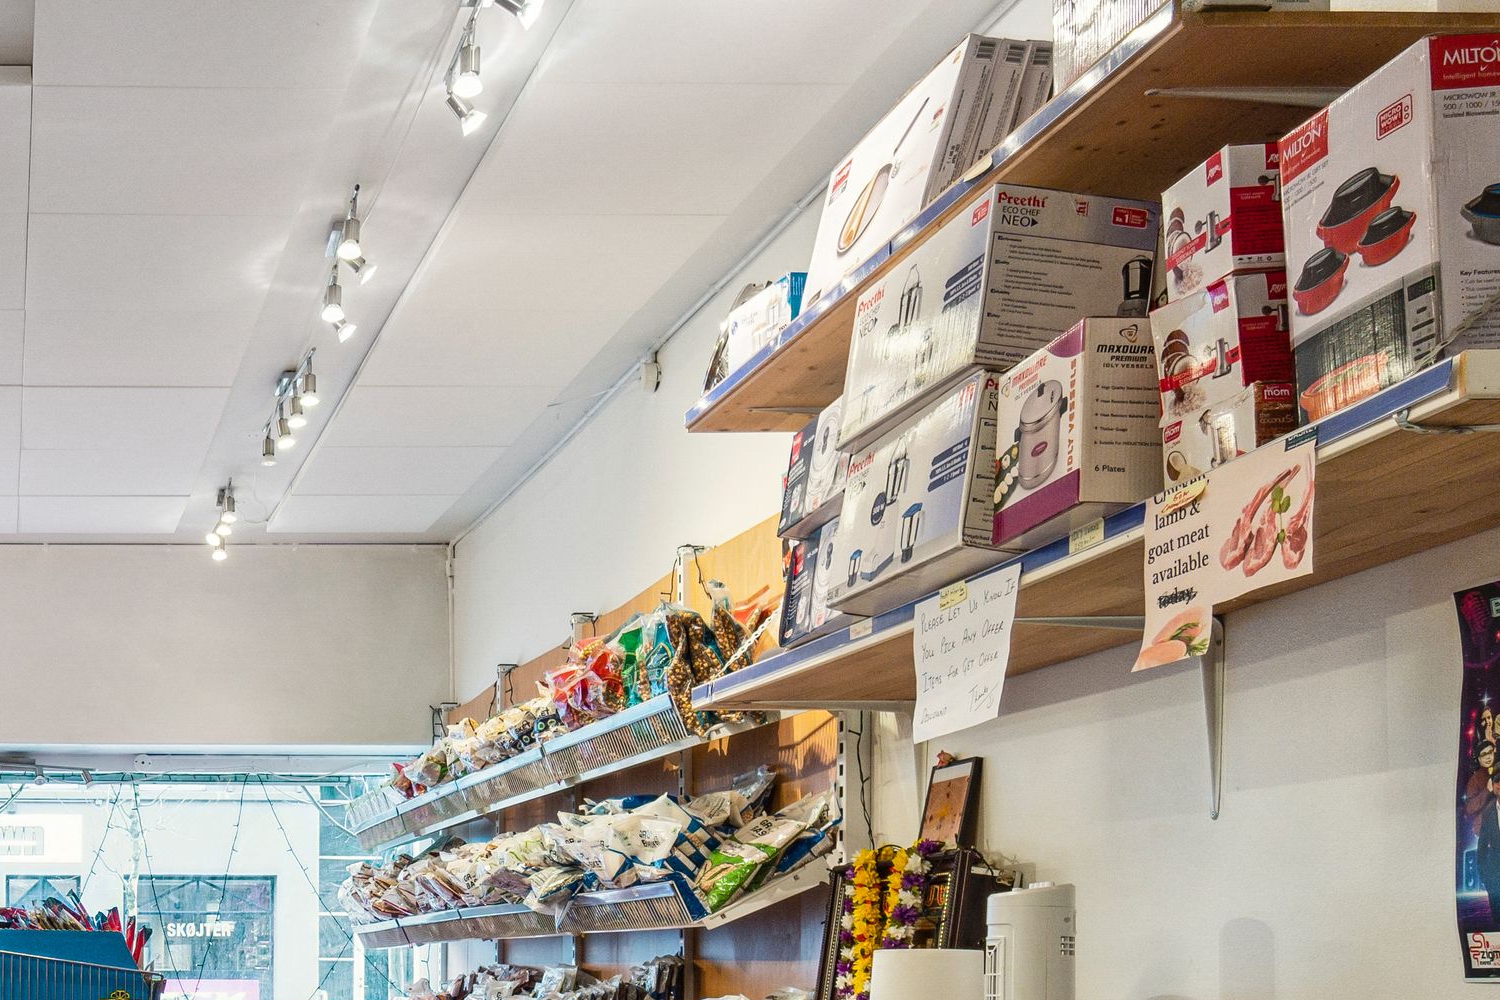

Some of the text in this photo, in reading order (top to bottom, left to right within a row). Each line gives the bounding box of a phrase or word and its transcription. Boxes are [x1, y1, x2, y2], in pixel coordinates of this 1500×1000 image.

[1443, 46, 1500, 66] MILTO
[1443, 71, 1476, 80] Intelligent
[1443, 101, 1483, 111] 500 1000
[1282, 125, 1322, 165] MILTON
[997, 191, 1046, 208] Preethi
[1002, 205, 1041, 217] ECO CHEF
[1001, 214, 1032, 228] NEO
[857, 286, 886, 315] Preethi
[1096, 344, 1155, 355] MAXOWAR
[1110, 355, 1147, 363] PREMIUM
[848, 450, 875, 478] Preethi
[1102, 464, 1126, 473] Plates
[1155, 501, 1201, 531] lamb &
[1147, 524, 1210, 565] goat meat
[1152, 553, 1210, 585] available
[948, 607, 961, 622] LET
[941, 636, 956, 654] PICK
[963, 628, 977, 645] ANY
[981, 619, 1004, 639] OFFER
[979, 651, 999, 667] OFFER
[167, 922, 233, 937] SKØJTER
